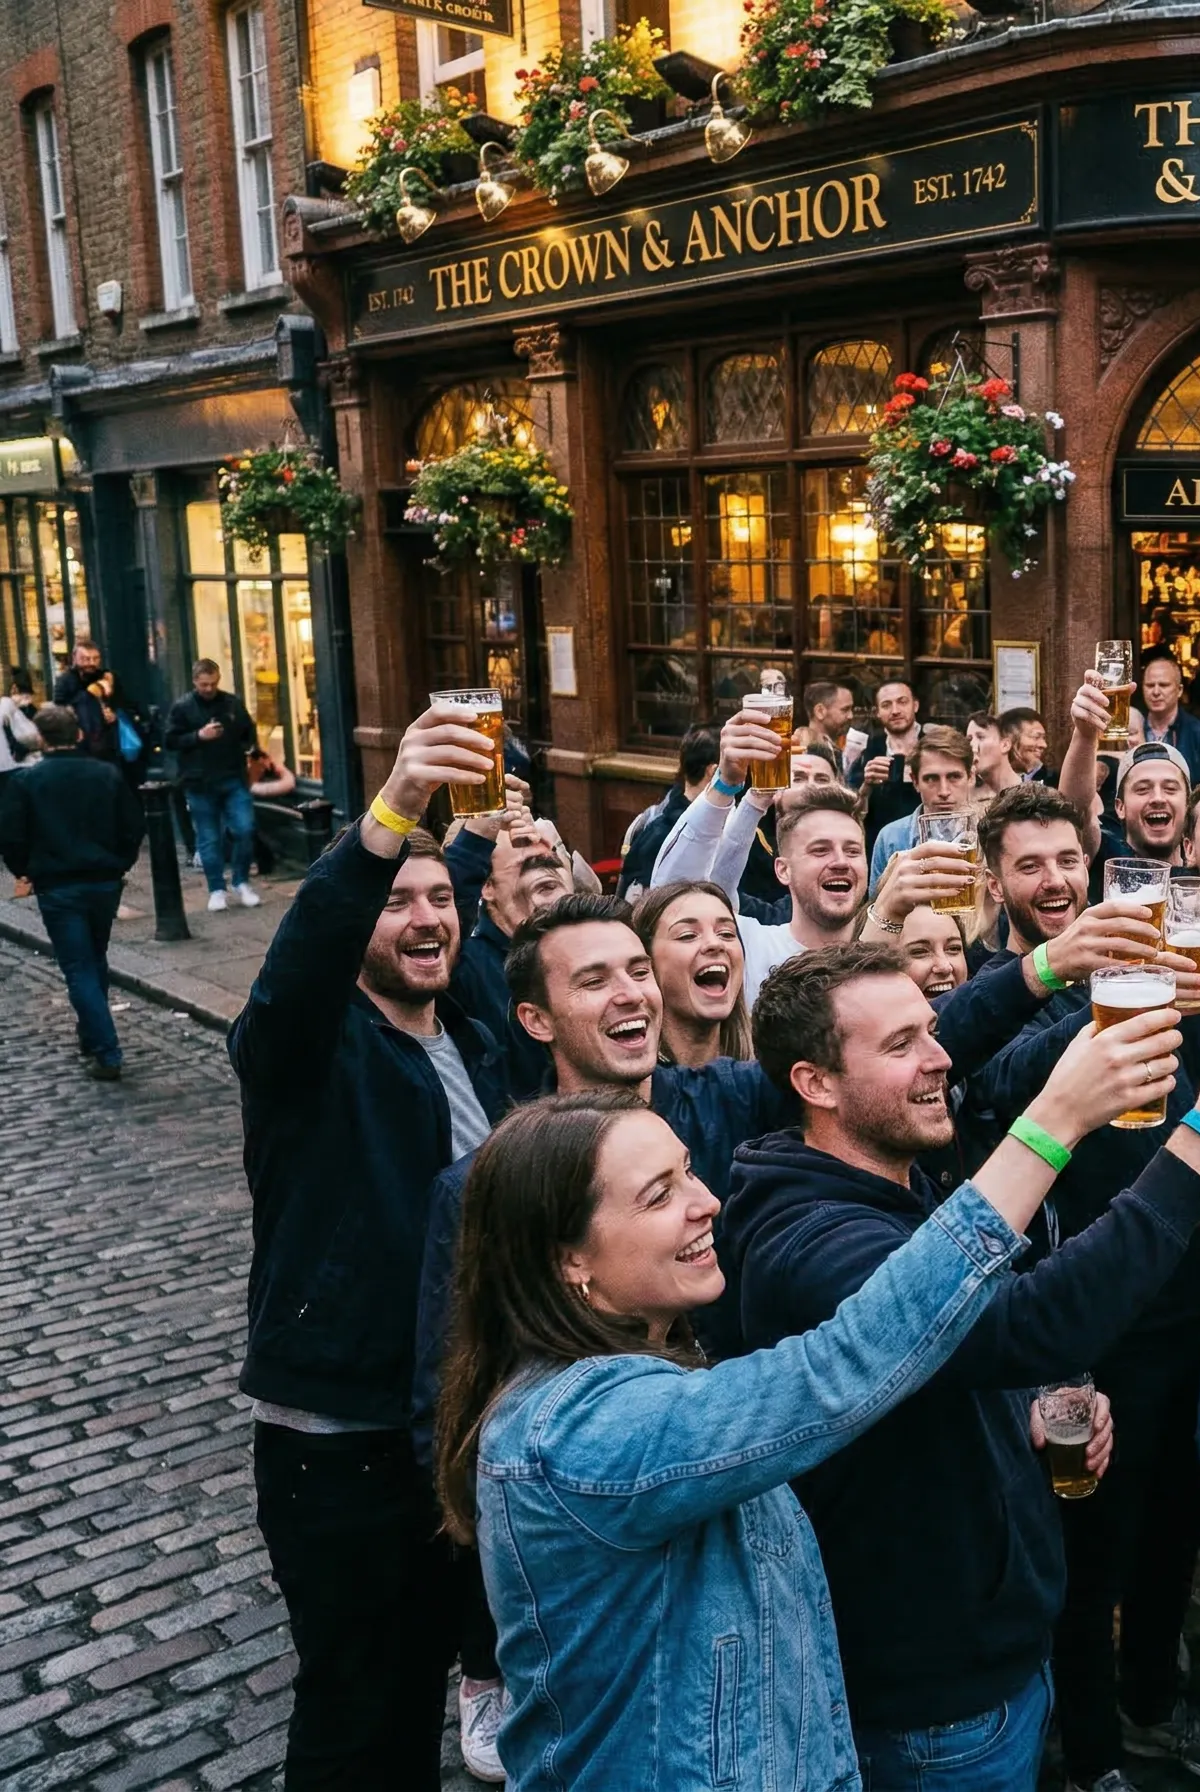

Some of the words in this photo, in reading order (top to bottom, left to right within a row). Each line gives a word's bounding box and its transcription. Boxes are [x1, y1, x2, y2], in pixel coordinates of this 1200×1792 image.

[913, 175, 956, 205] EST.
[963, 163, 1006, 196] 1742
[429, 257, 492, 312] THE
[499, 225, 632, 299] CROWN
[641, 219, 675, 272] &
[682, 173, 886, 265] ANCHOR
